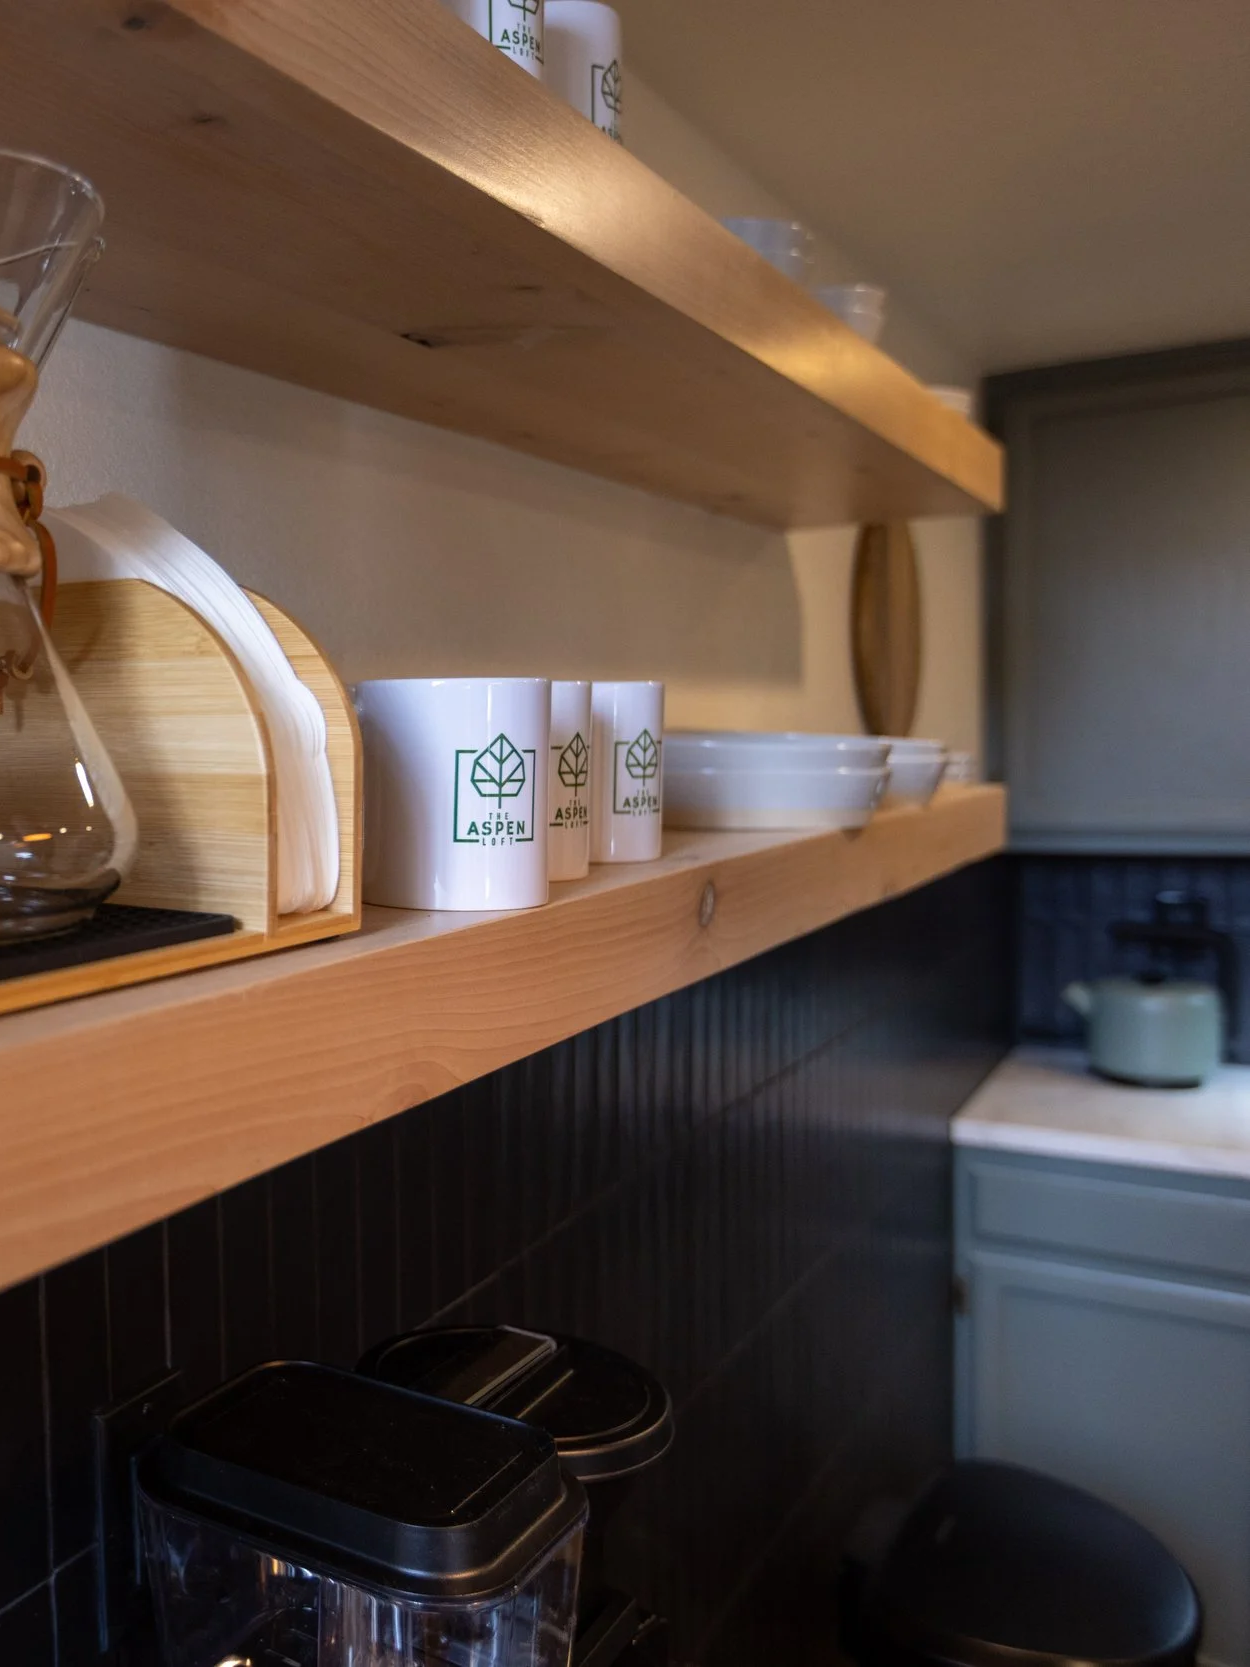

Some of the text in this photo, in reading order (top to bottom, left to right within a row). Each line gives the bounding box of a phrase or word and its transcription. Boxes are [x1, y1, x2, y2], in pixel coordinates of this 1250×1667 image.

[500, 29, 541, 52] ASPEN
[623, 796, 658, 808] ASPEN
[489, 812, 509, 820] THE
[555, 806, 588, 820] ASPEN
[467, 821, 525, 836] ASPEN
[482, 837, 514, 846] LOFT
